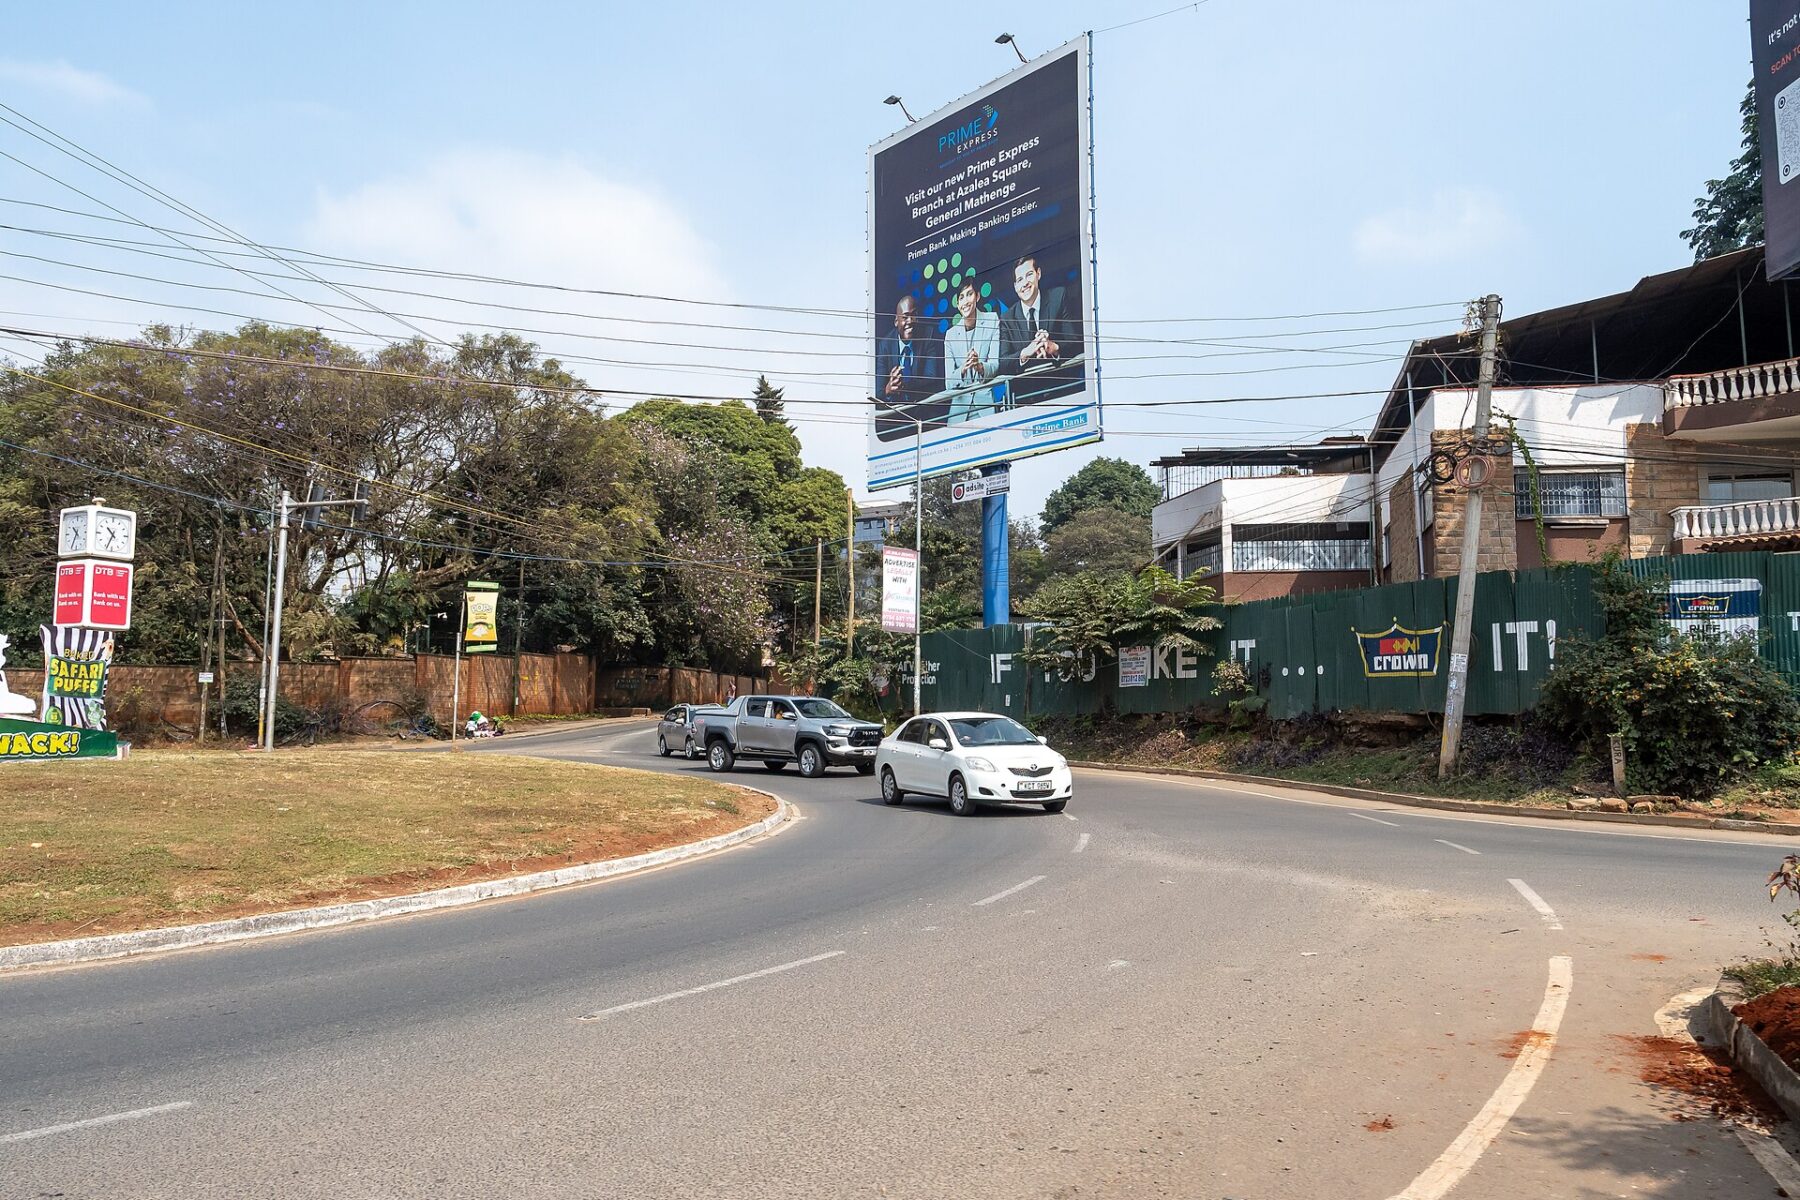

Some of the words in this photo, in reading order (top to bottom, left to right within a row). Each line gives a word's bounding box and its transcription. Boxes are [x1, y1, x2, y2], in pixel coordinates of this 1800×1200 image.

[1768, 29, 1782, 45] It's
[1782, 14, 1798, 34] not
[1771, 53, 1792, 74] SCAN
[938, 117, 982, 153] PRIME
[956, 127, 999, 154] EXPRESS
[905, 189, 926, 206] Visit
[926, 182, 944, 196] our
[944, 172, 966, 191] new
[966, 157, 997, 179] Prime
[998, 136, 1040, 163] Express
[912, 199, 945, 220] Branch
[945, 192, 957, 205] at
[956, 175, 991, 199] Azalea
[992, 159, 1033, 184] Square,
[925, 207, 963, 229] General
[964, 181, 1017, 209] Mathenge
[907, 247, 928, 261] Prime
[928, 239, 949, 254] Bank.
[949, 226, 977, 244] Making
[978, 213, 1010, 233] Banking
[1010, 200, 1038, 217] Easier.
[1035, 423, 1061, 434] Prime
[1062, 414, 1086, 428] Bank
[60, 567, 74, 576] DTB
[95, 566, 114, 576] DTB
[884, 558, 916, 568] ADVERTISE
[892, 576, 907, 584] WITH
[63, 648, 96, 660] BAKED
[1373, 653, 1429, 671] crown
[50, 658, 105, 680] SAFARI
[990, 653, 1012, 684] IF
[53, 676, 99, 694] PUFFS
[901, 674, 937, 685] Proction
